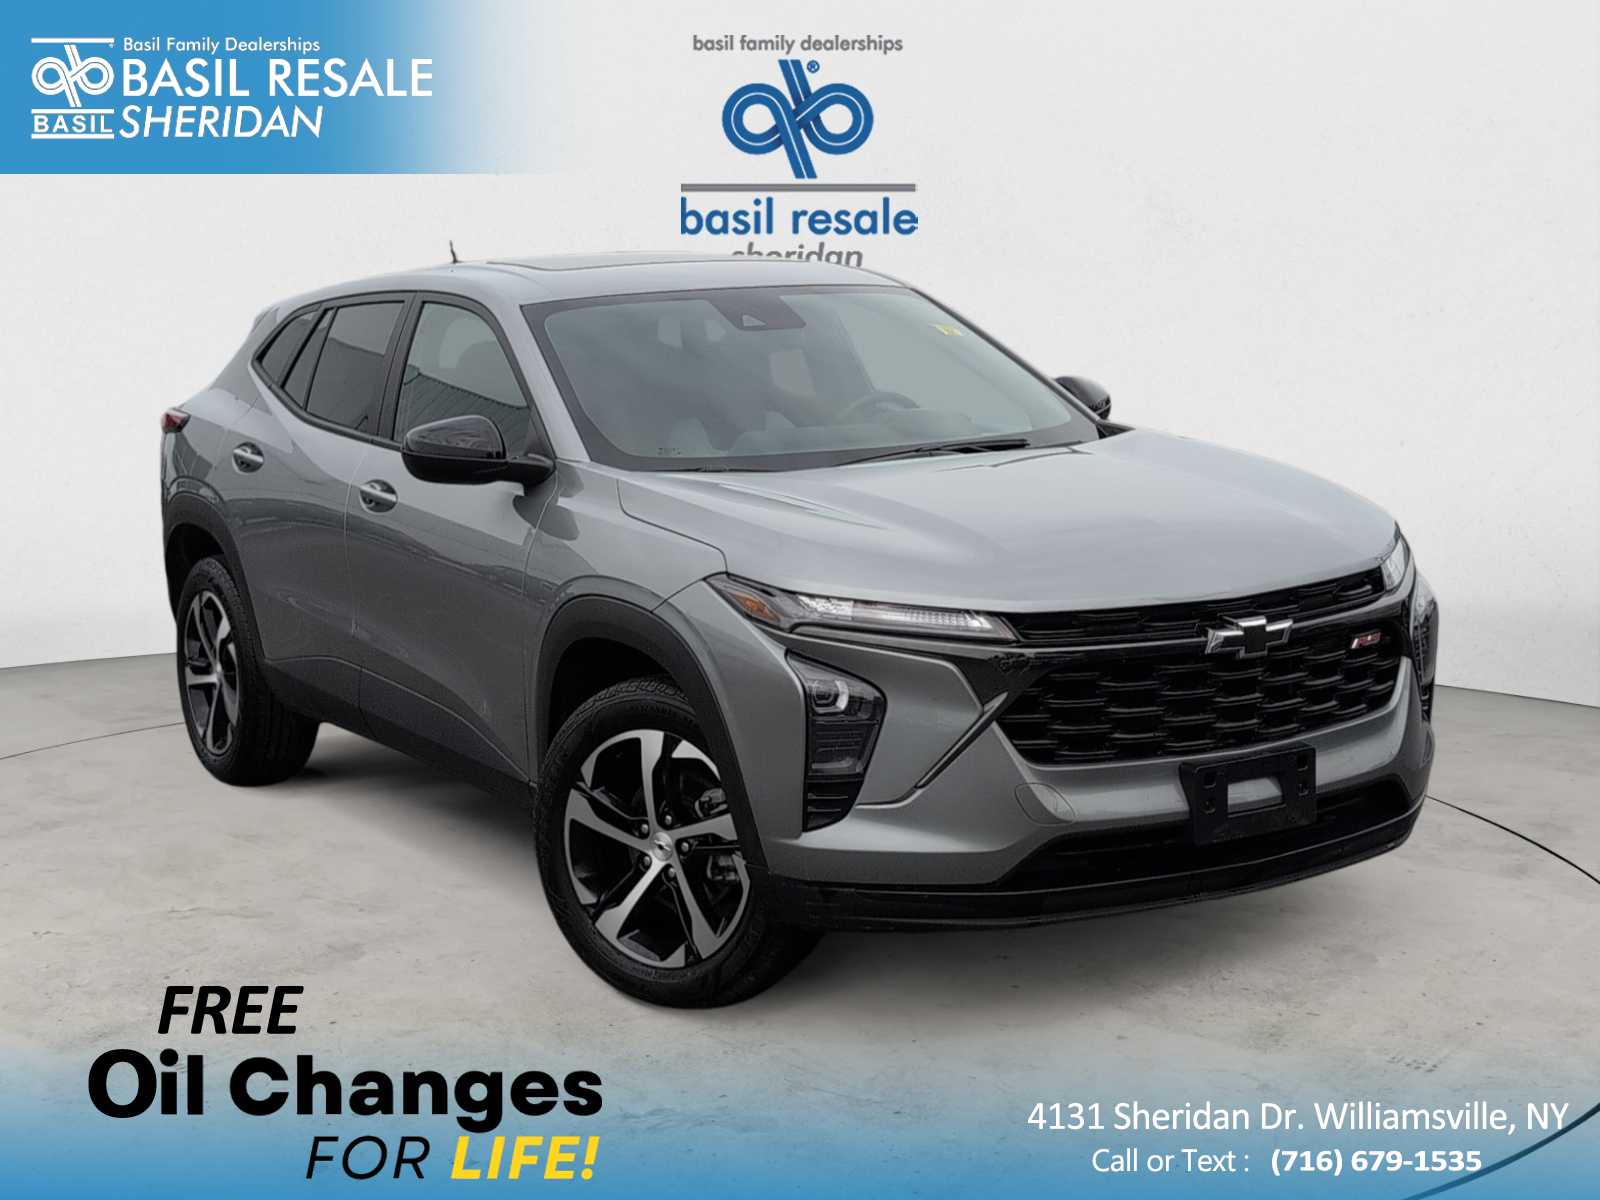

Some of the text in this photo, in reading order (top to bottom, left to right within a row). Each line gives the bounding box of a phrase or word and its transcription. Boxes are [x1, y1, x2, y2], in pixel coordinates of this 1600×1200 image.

[693, 34, 904, 55] basil family dealerships
[681, 196, 919, 236] basil resale
